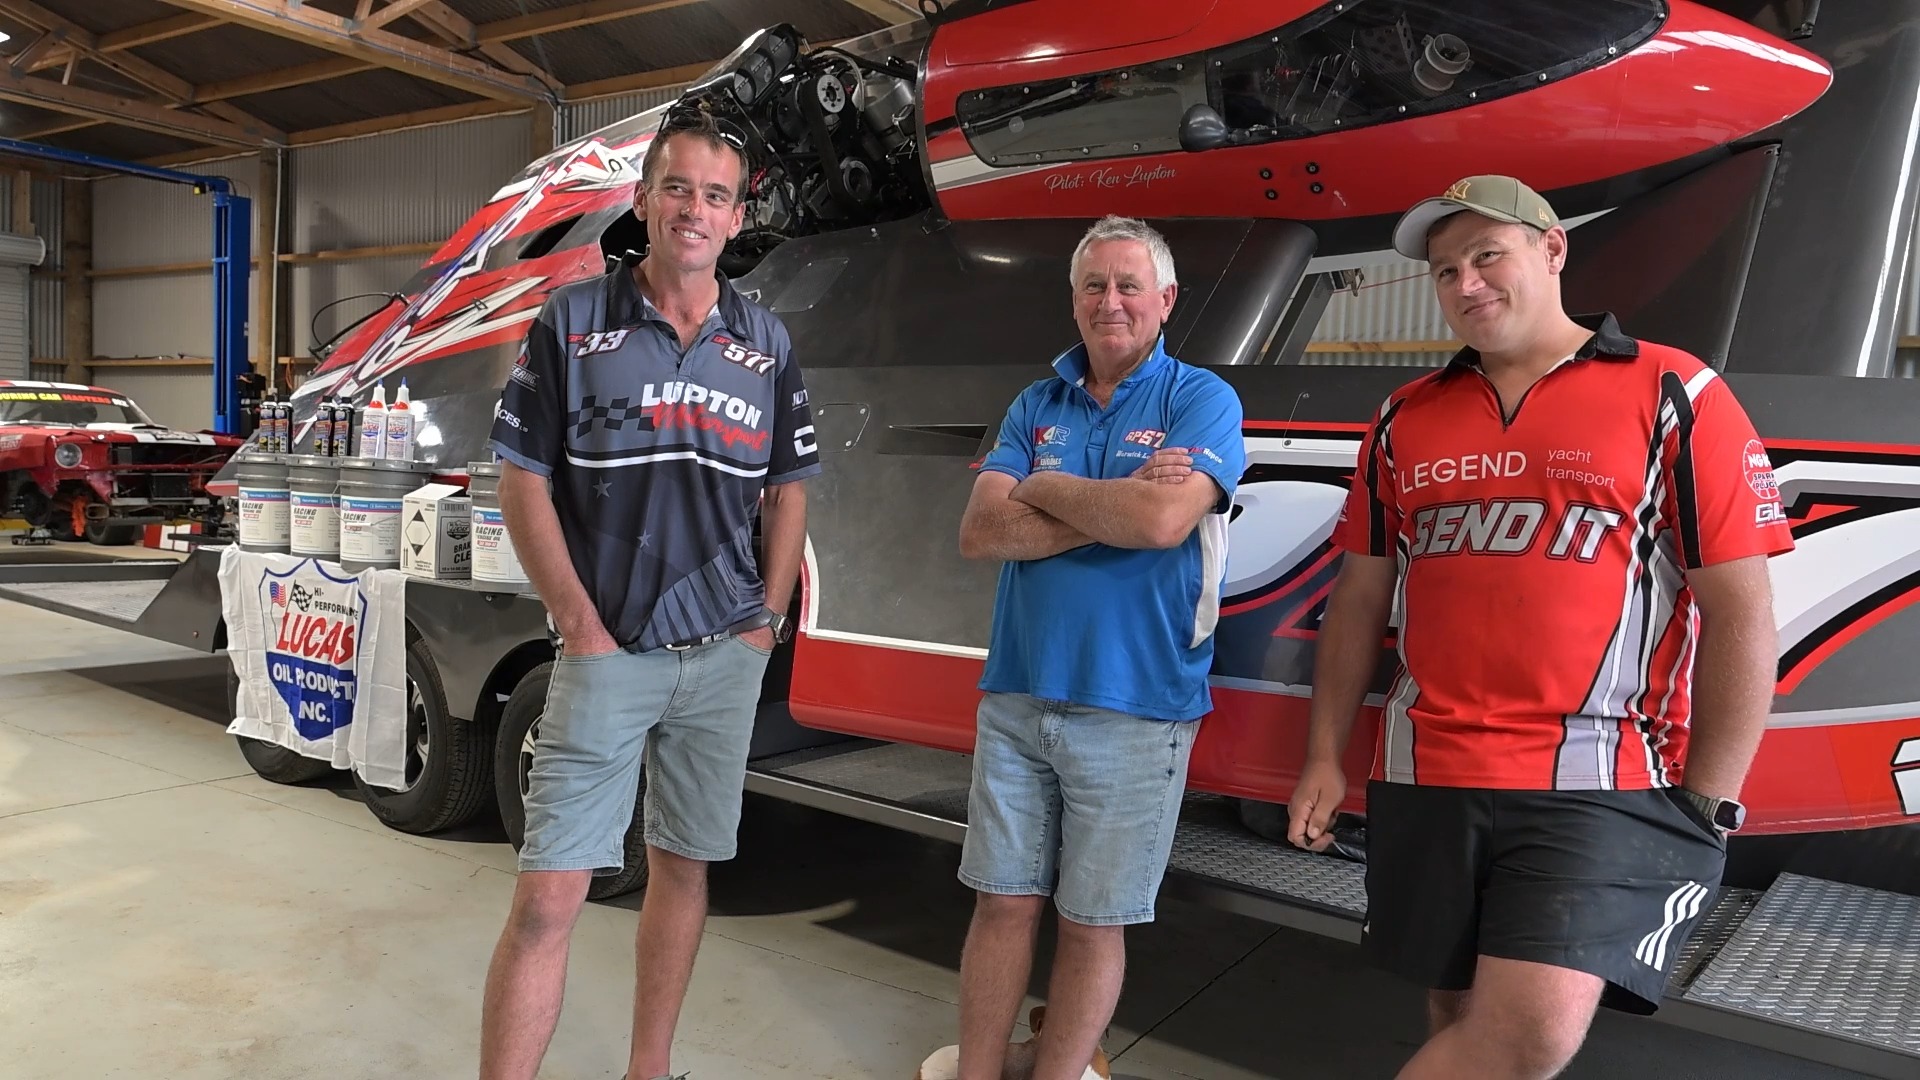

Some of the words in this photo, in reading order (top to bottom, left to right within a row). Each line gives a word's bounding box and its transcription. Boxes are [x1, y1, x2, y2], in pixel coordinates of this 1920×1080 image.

[1044, 174, 1085, 193] Pilot:
[1089, 168, 1121, 188] Ken
[1124, 163, 1177, 188] Lupton
[577, 329, 629, 357] 33
[724, 342, 776, 375] 577
[38, 392, 62, 401] CAR
[641, 381, 763, 430] LUPTON
[1547, 448, 1592, 464] yacht
[1401, 451, 1527, 495] LEGEND
[1546, 465, 1616, 489] transport
[242, 502, 264, 510] RACING
[294, 507, 318, 516] RACING
[343, 512, 367, 521] RACING
[475, 525, 504, 536] RACING
[1411, 499, 1546, 558] SEND
[1548, 502, 1625, 561] IT
[276, 611, 355, 665] LUCAS
[272, 662, 294, 684] OIL
